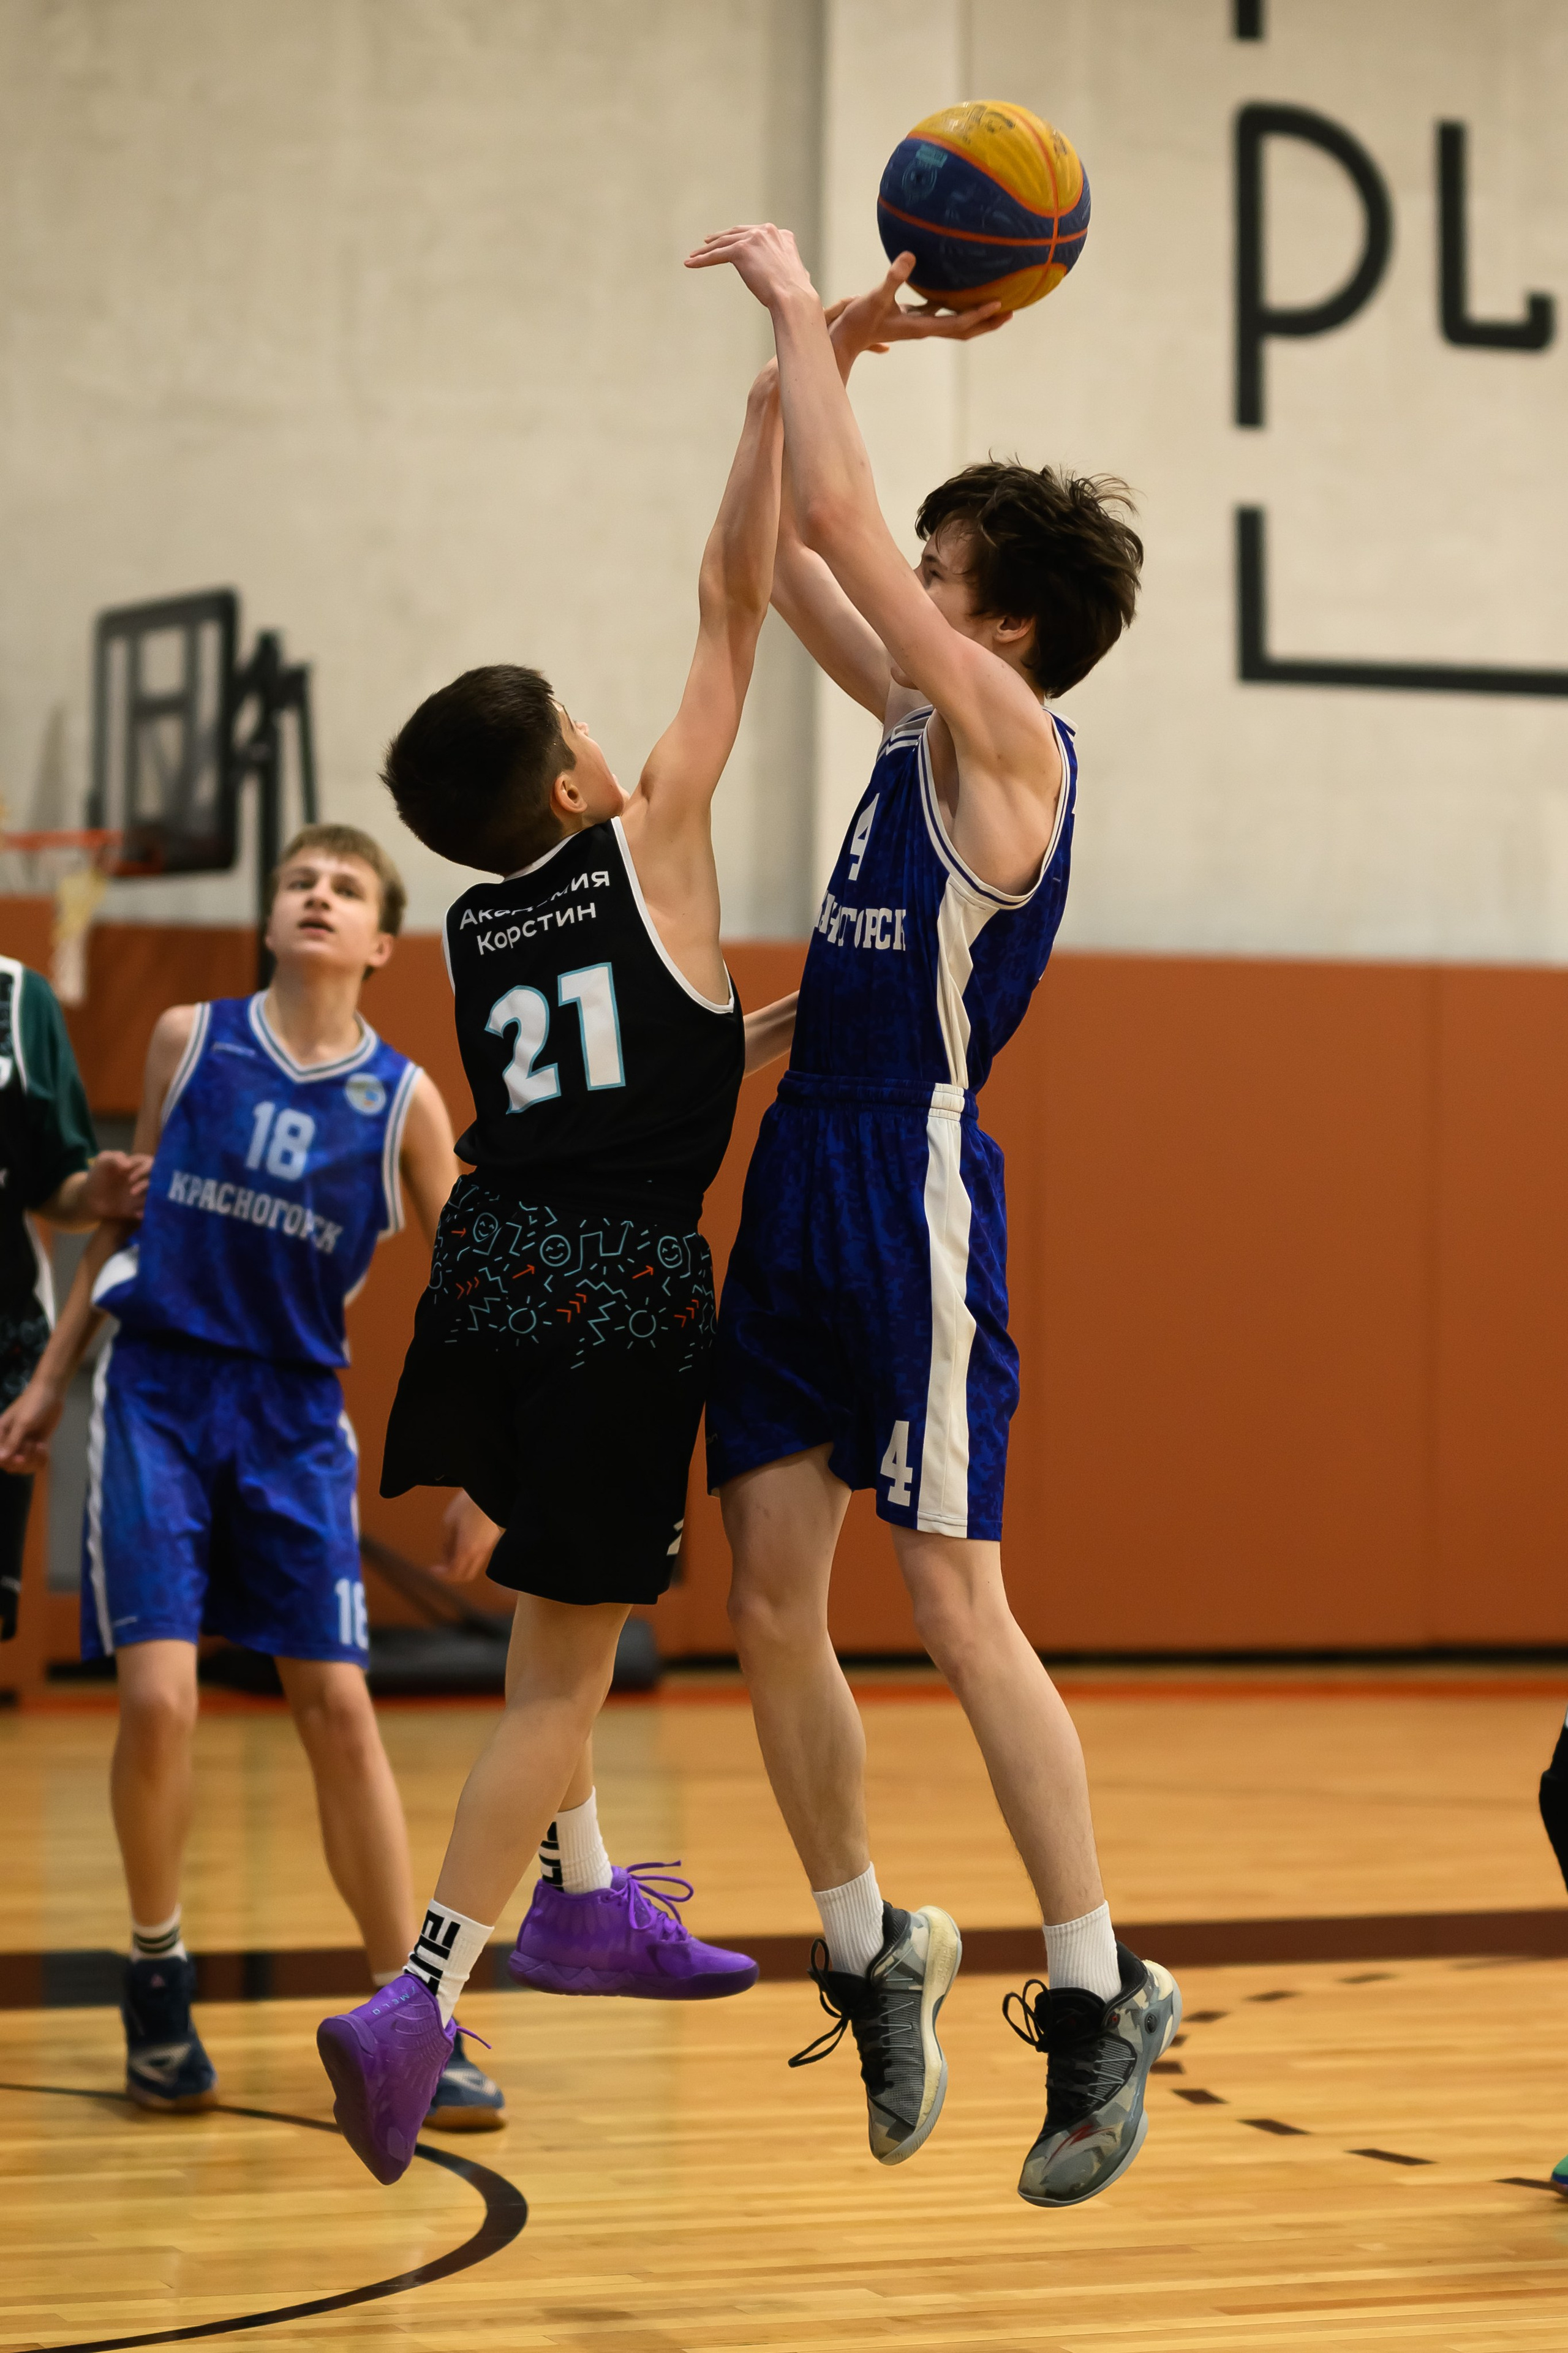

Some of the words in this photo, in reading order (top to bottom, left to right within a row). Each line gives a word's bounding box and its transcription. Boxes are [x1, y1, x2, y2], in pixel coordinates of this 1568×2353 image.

[484, 962, 626, 1115] 21
[245, 1101, 316, 1181] 18
[168, 1169, 343, 1254] КРАСНОГОРСК
[880, 1420, 913, 1507] 4
